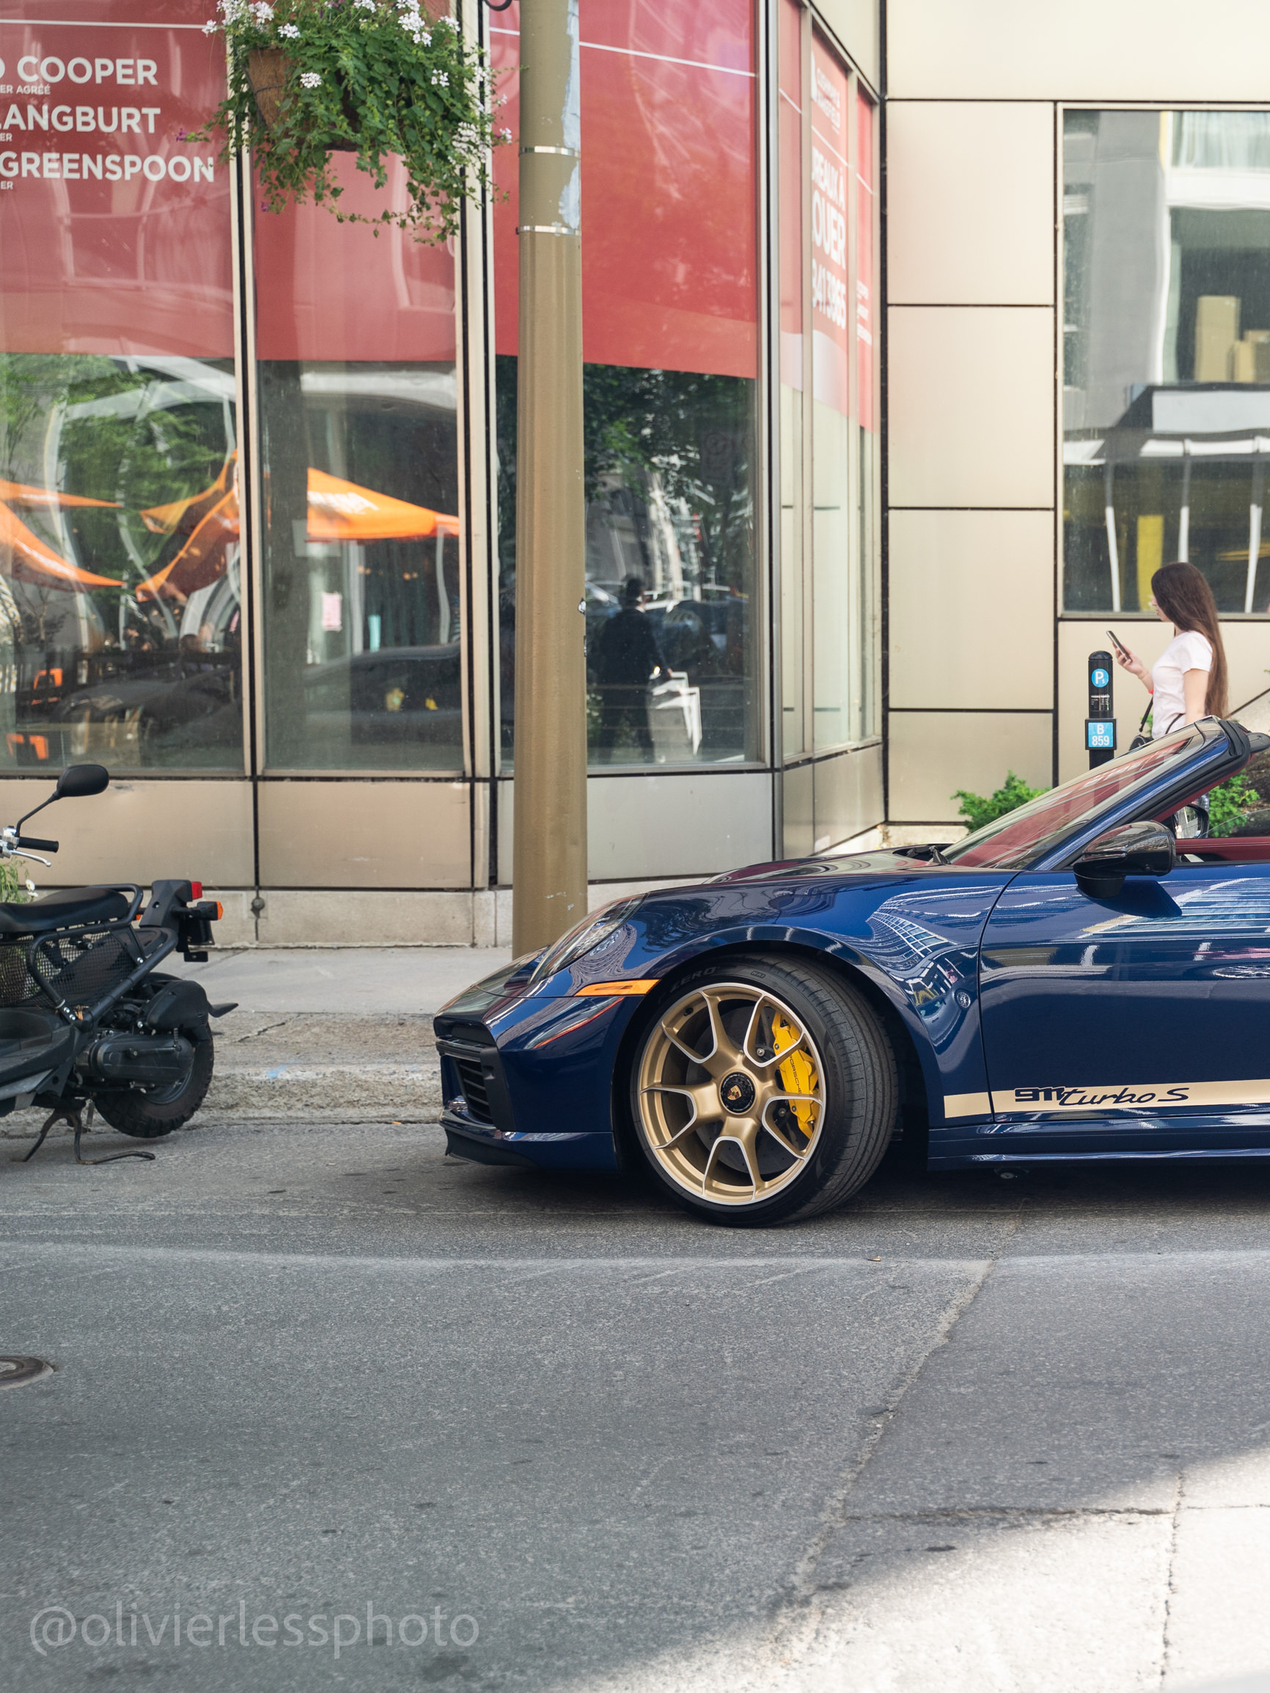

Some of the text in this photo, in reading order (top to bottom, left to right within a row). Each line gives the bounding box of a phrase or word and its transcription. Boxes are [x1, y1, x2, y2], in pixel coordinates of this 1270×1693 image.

[17, 55, 158, 85] COOPER
[16, 84, 50, 95] AGRÉÉ
[0, 104, 161, 133] ANGBURT
[0, 151, 214, 182] GREENSPOON
[812, 189, 846, 270] OUER
[1091, 736, 1110, 746] 859
[1097, 724, 1105, 734] B
[1015, 1087, 1190, 1106] 911 turbo S
